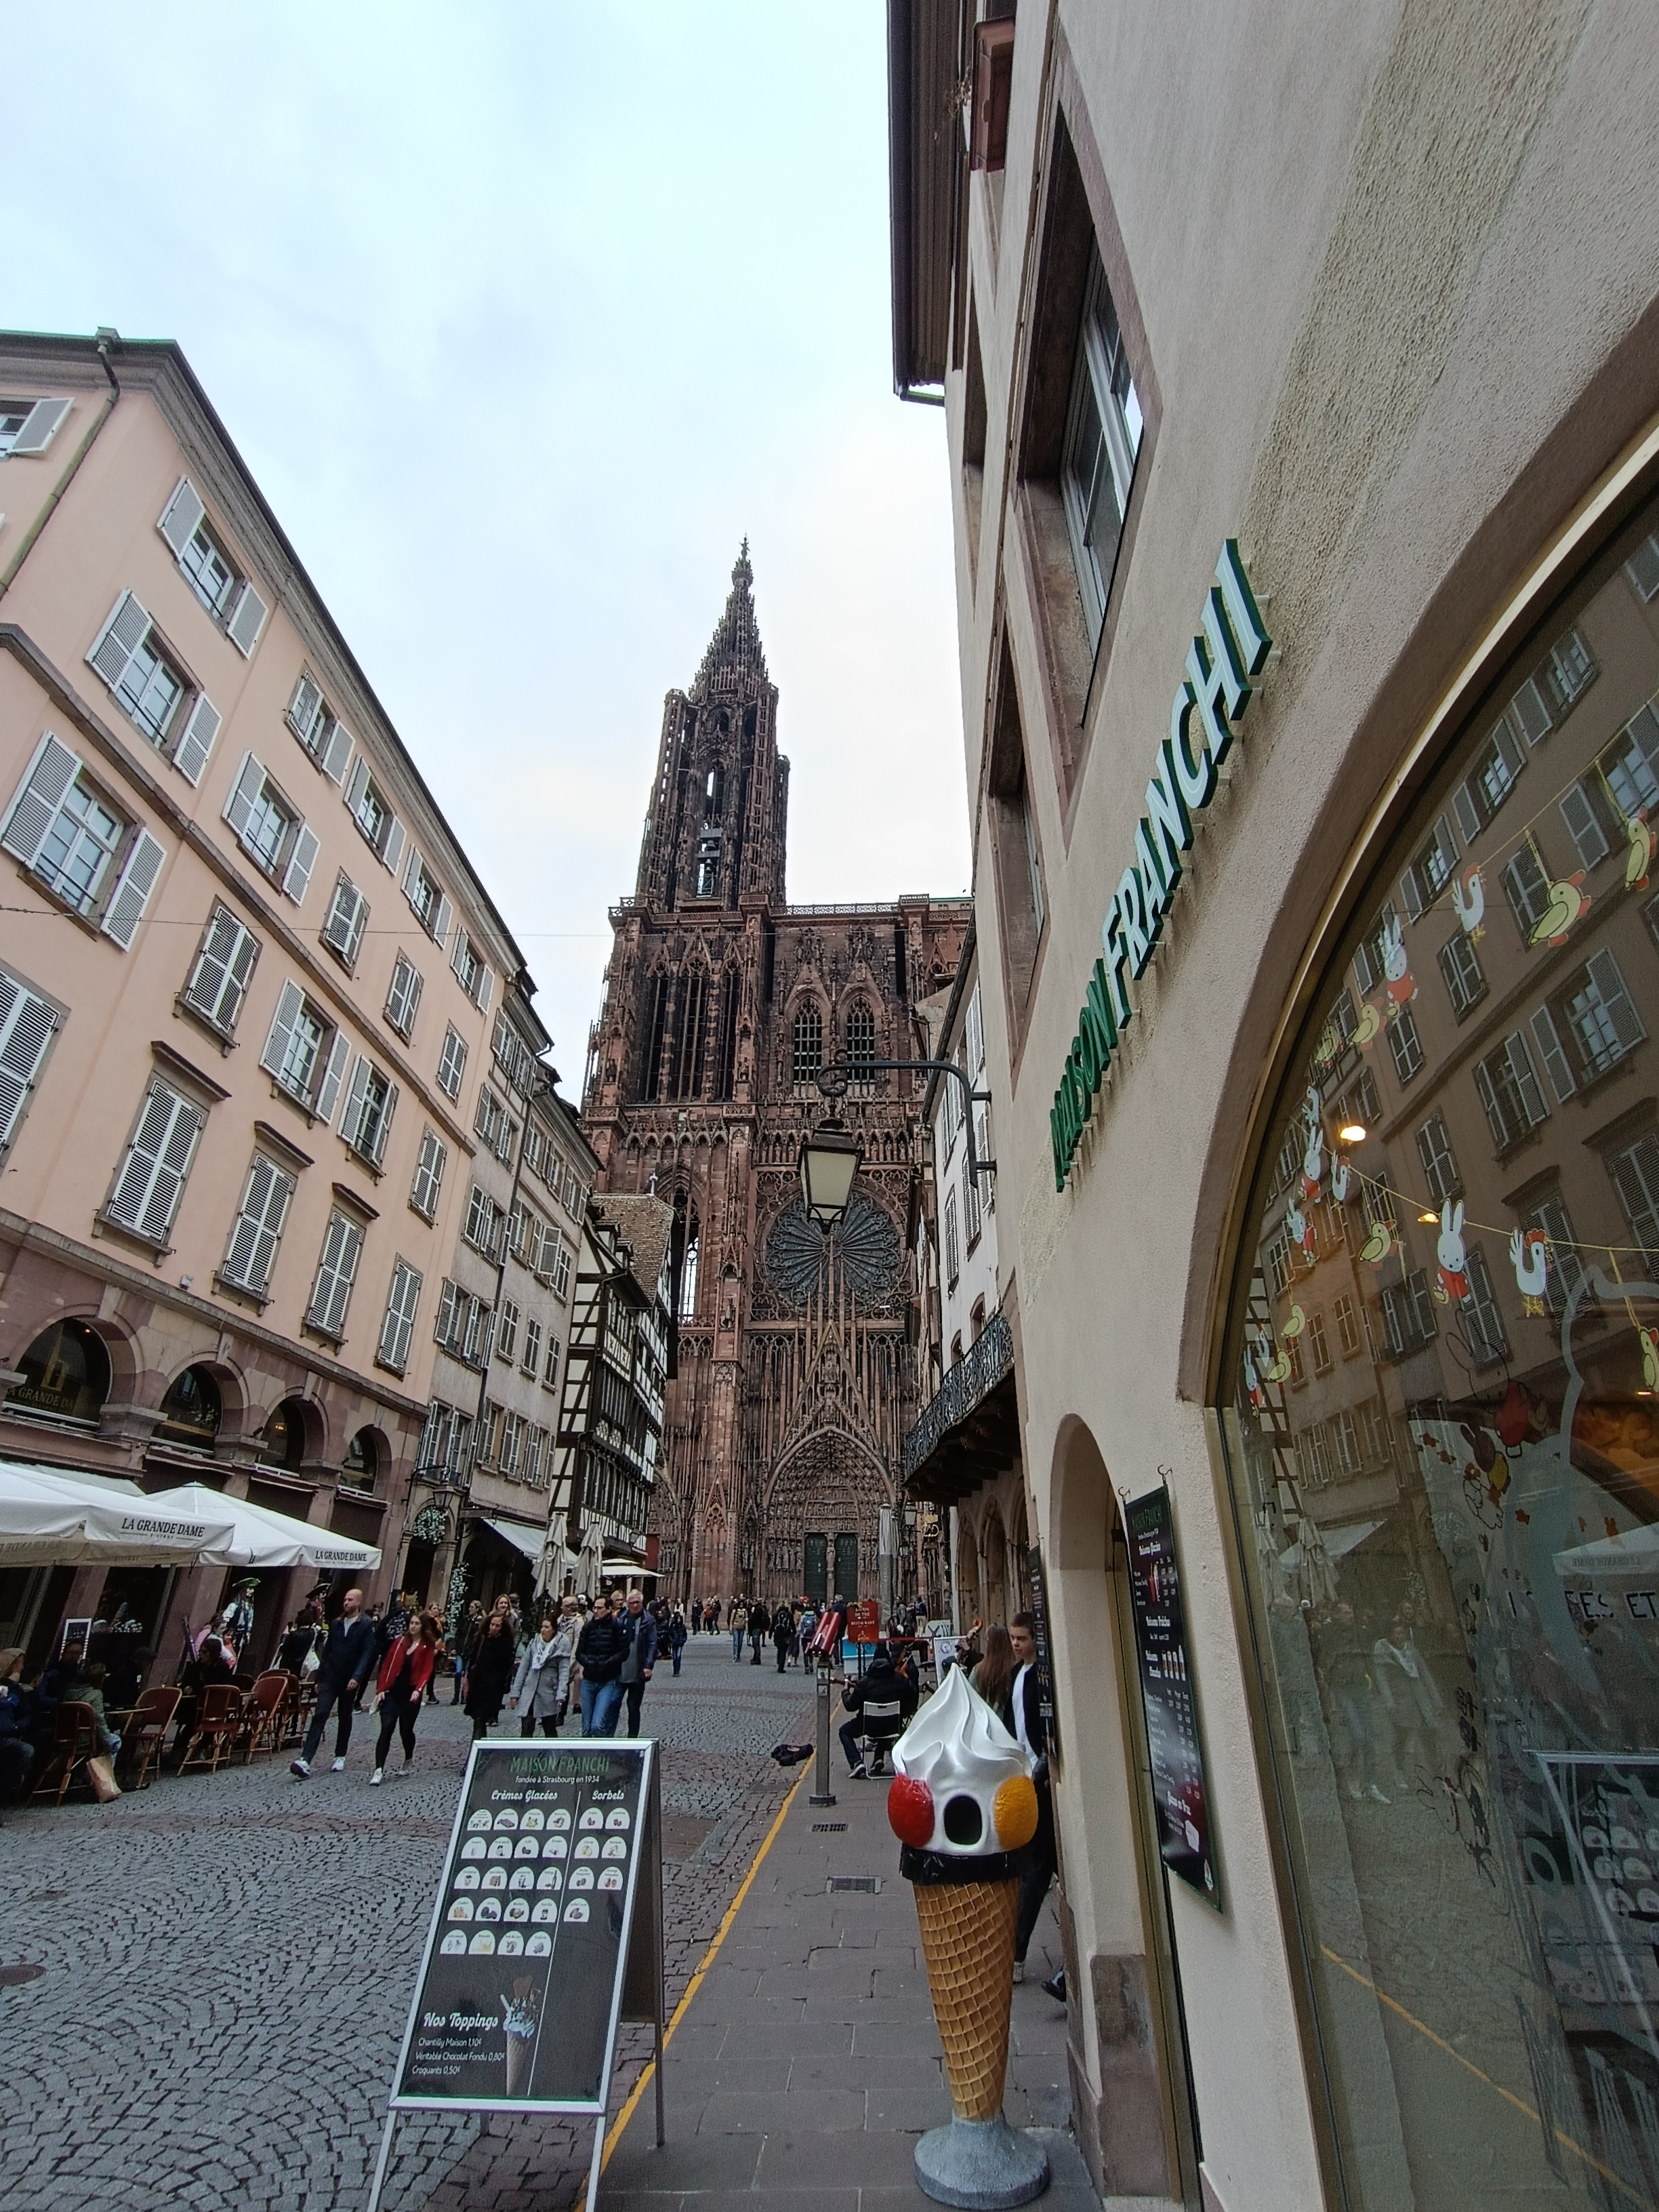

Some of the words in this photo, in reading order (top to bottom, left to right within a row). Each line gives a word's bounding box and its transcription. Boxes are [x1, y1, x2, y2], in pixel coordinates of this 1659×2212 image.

[1050, 958, 1119, 1194] MAISON
[1103, 538, 1272, 1030] FRANCHI
[18, 1387, 60, 1406] GRANDE
[121, 1518, 134, 1530] LA
[137, 1519, 177, 1534] GRANDE
[177, 1524, 205, 1537] DAME
[316, 1550, 323, 1559] LA
[325, 1551, 349, 1561] GRANDE
[349, 1553, 367, 1561] DAME
[510, 1757, 556, 1773] MAISON
[557, 1757, 610, 1772] FRANCHI
[542, 1776, 575, 1784] Strasbourg
[491, 1790, 523, 1800] Crèmes
[525, 1790, 558, 1802] Glacées
[592, 1790, 624, 1800] Sorbets
[424, 2012, 446, 2027] Nos
[449, 2012, 498, 2031] Toppings
[419, 2037, 445, 2049] Chantilly
[445, 2038, 467, 2047] Maison
[416, 2051, 442, 2060] Véritable
[443, 2051, 468, 2060] Chocolat
[469, 2052, 487, 2060] Fondu
[412, 2065, 442, 2076] Croquants
